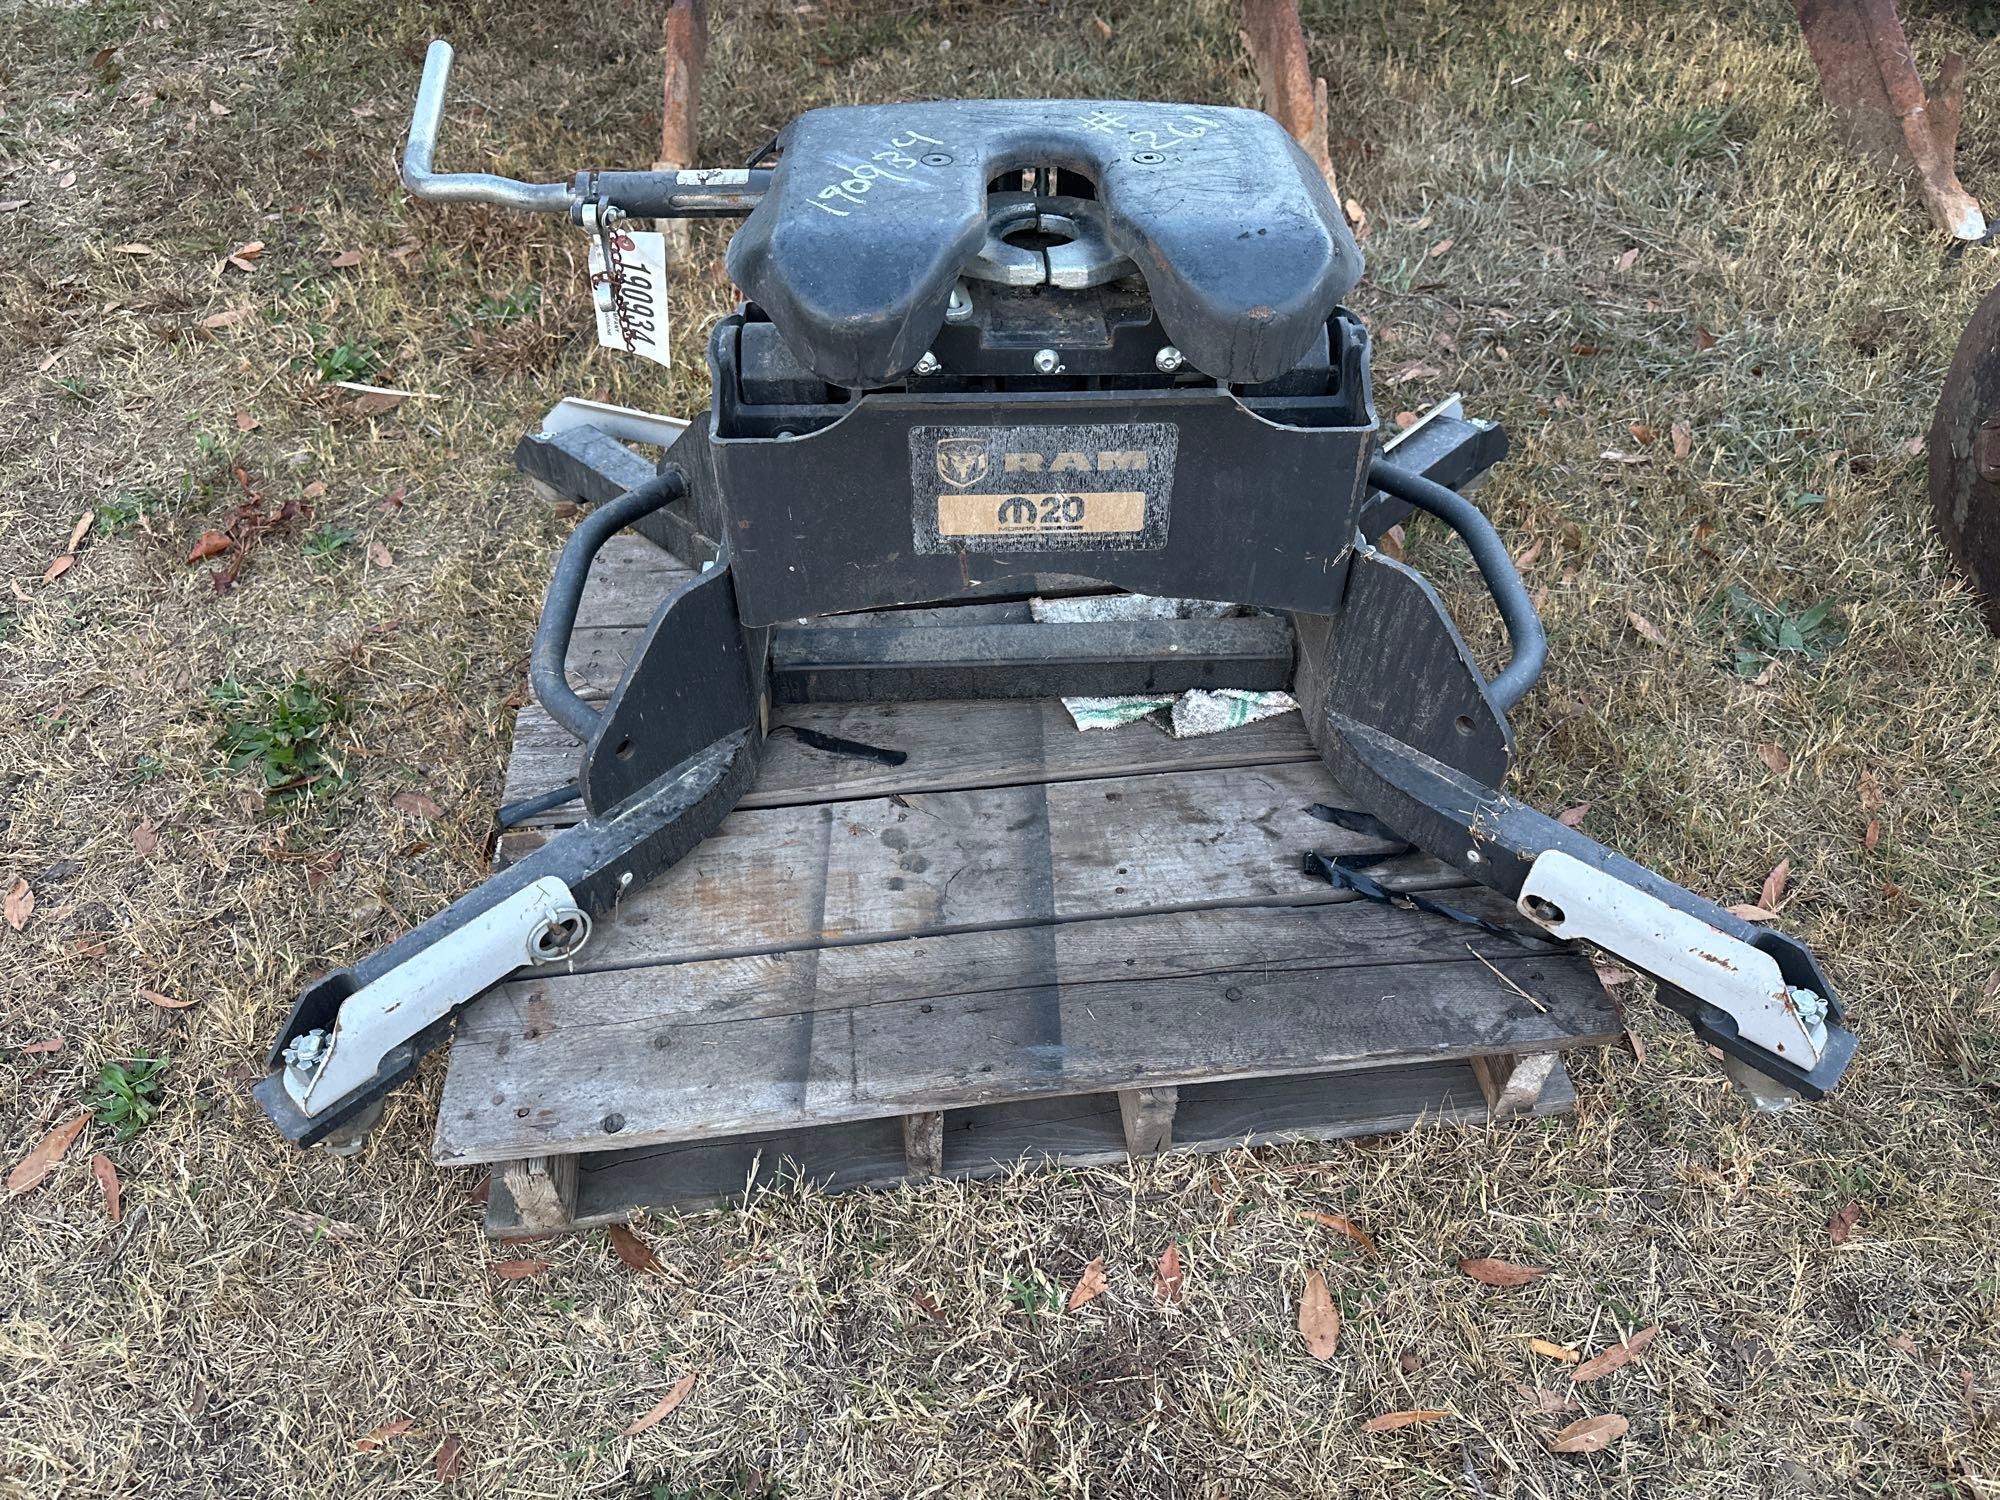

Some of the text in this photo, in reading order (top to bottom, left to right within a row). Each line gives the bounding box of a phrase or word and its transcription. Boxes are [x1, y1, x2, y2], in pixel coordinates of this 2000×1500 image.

[806, 131, 944, 216] 190934
[621, 264, 656, 346] 190934
[1005, 451, 1147, 472] RAM
